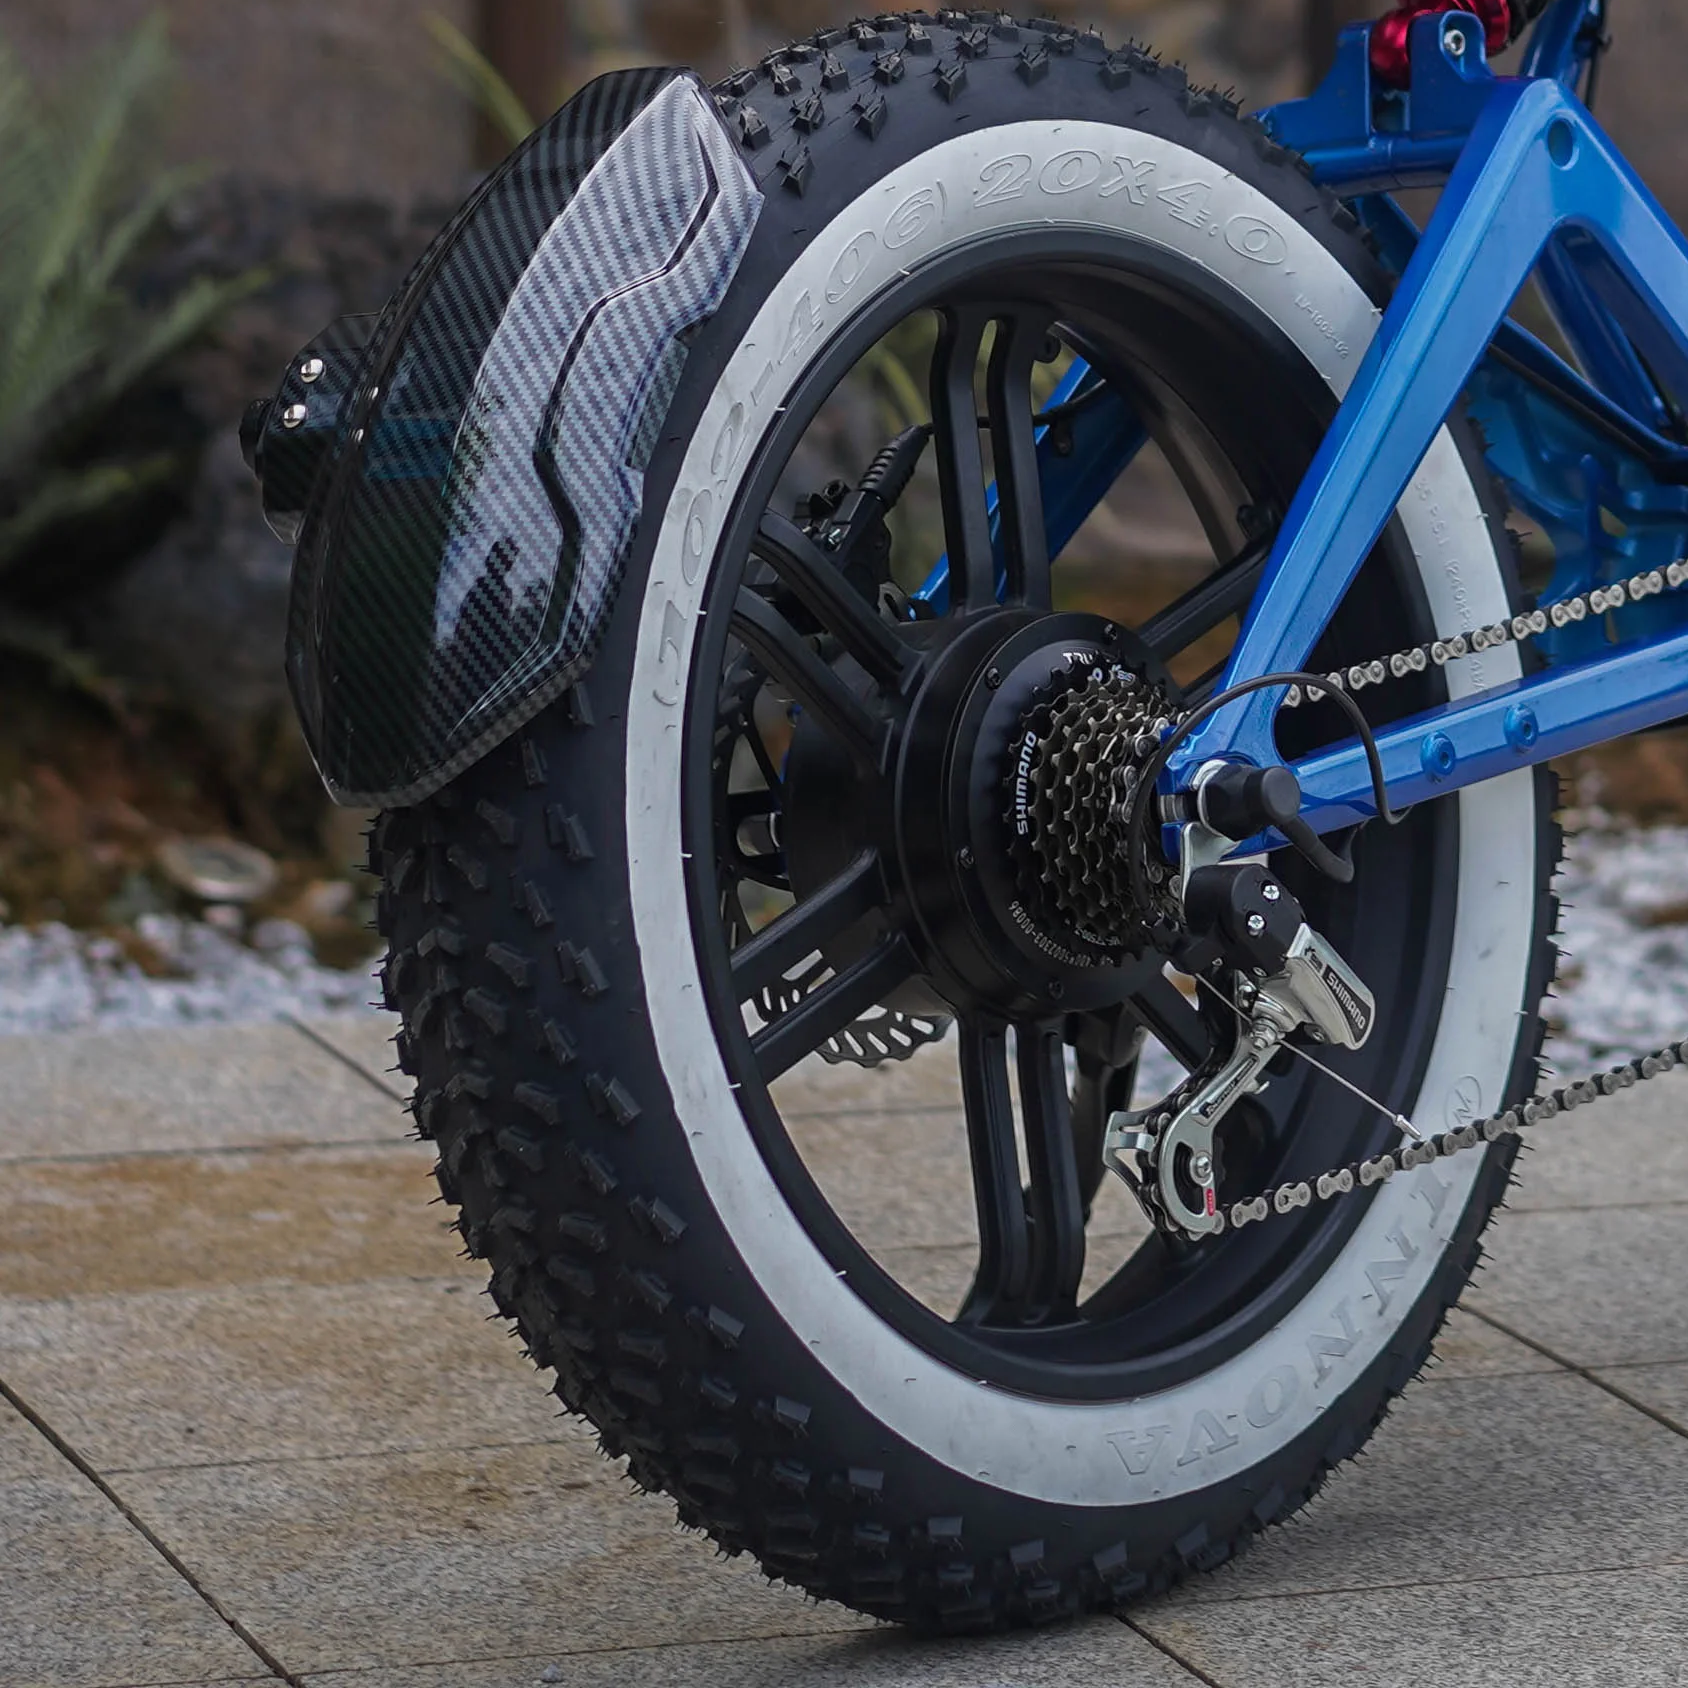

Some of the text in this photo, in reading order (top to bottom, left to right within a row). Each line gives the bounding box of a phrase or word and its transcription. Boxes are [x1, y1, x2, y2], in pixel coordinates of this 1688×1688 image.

[1015, 730, 1038, 836] SHIMANO
[1326, 972, 1366, 1029] SHIMANO
[1107, 1169, 1453, 1475] INNOVA
